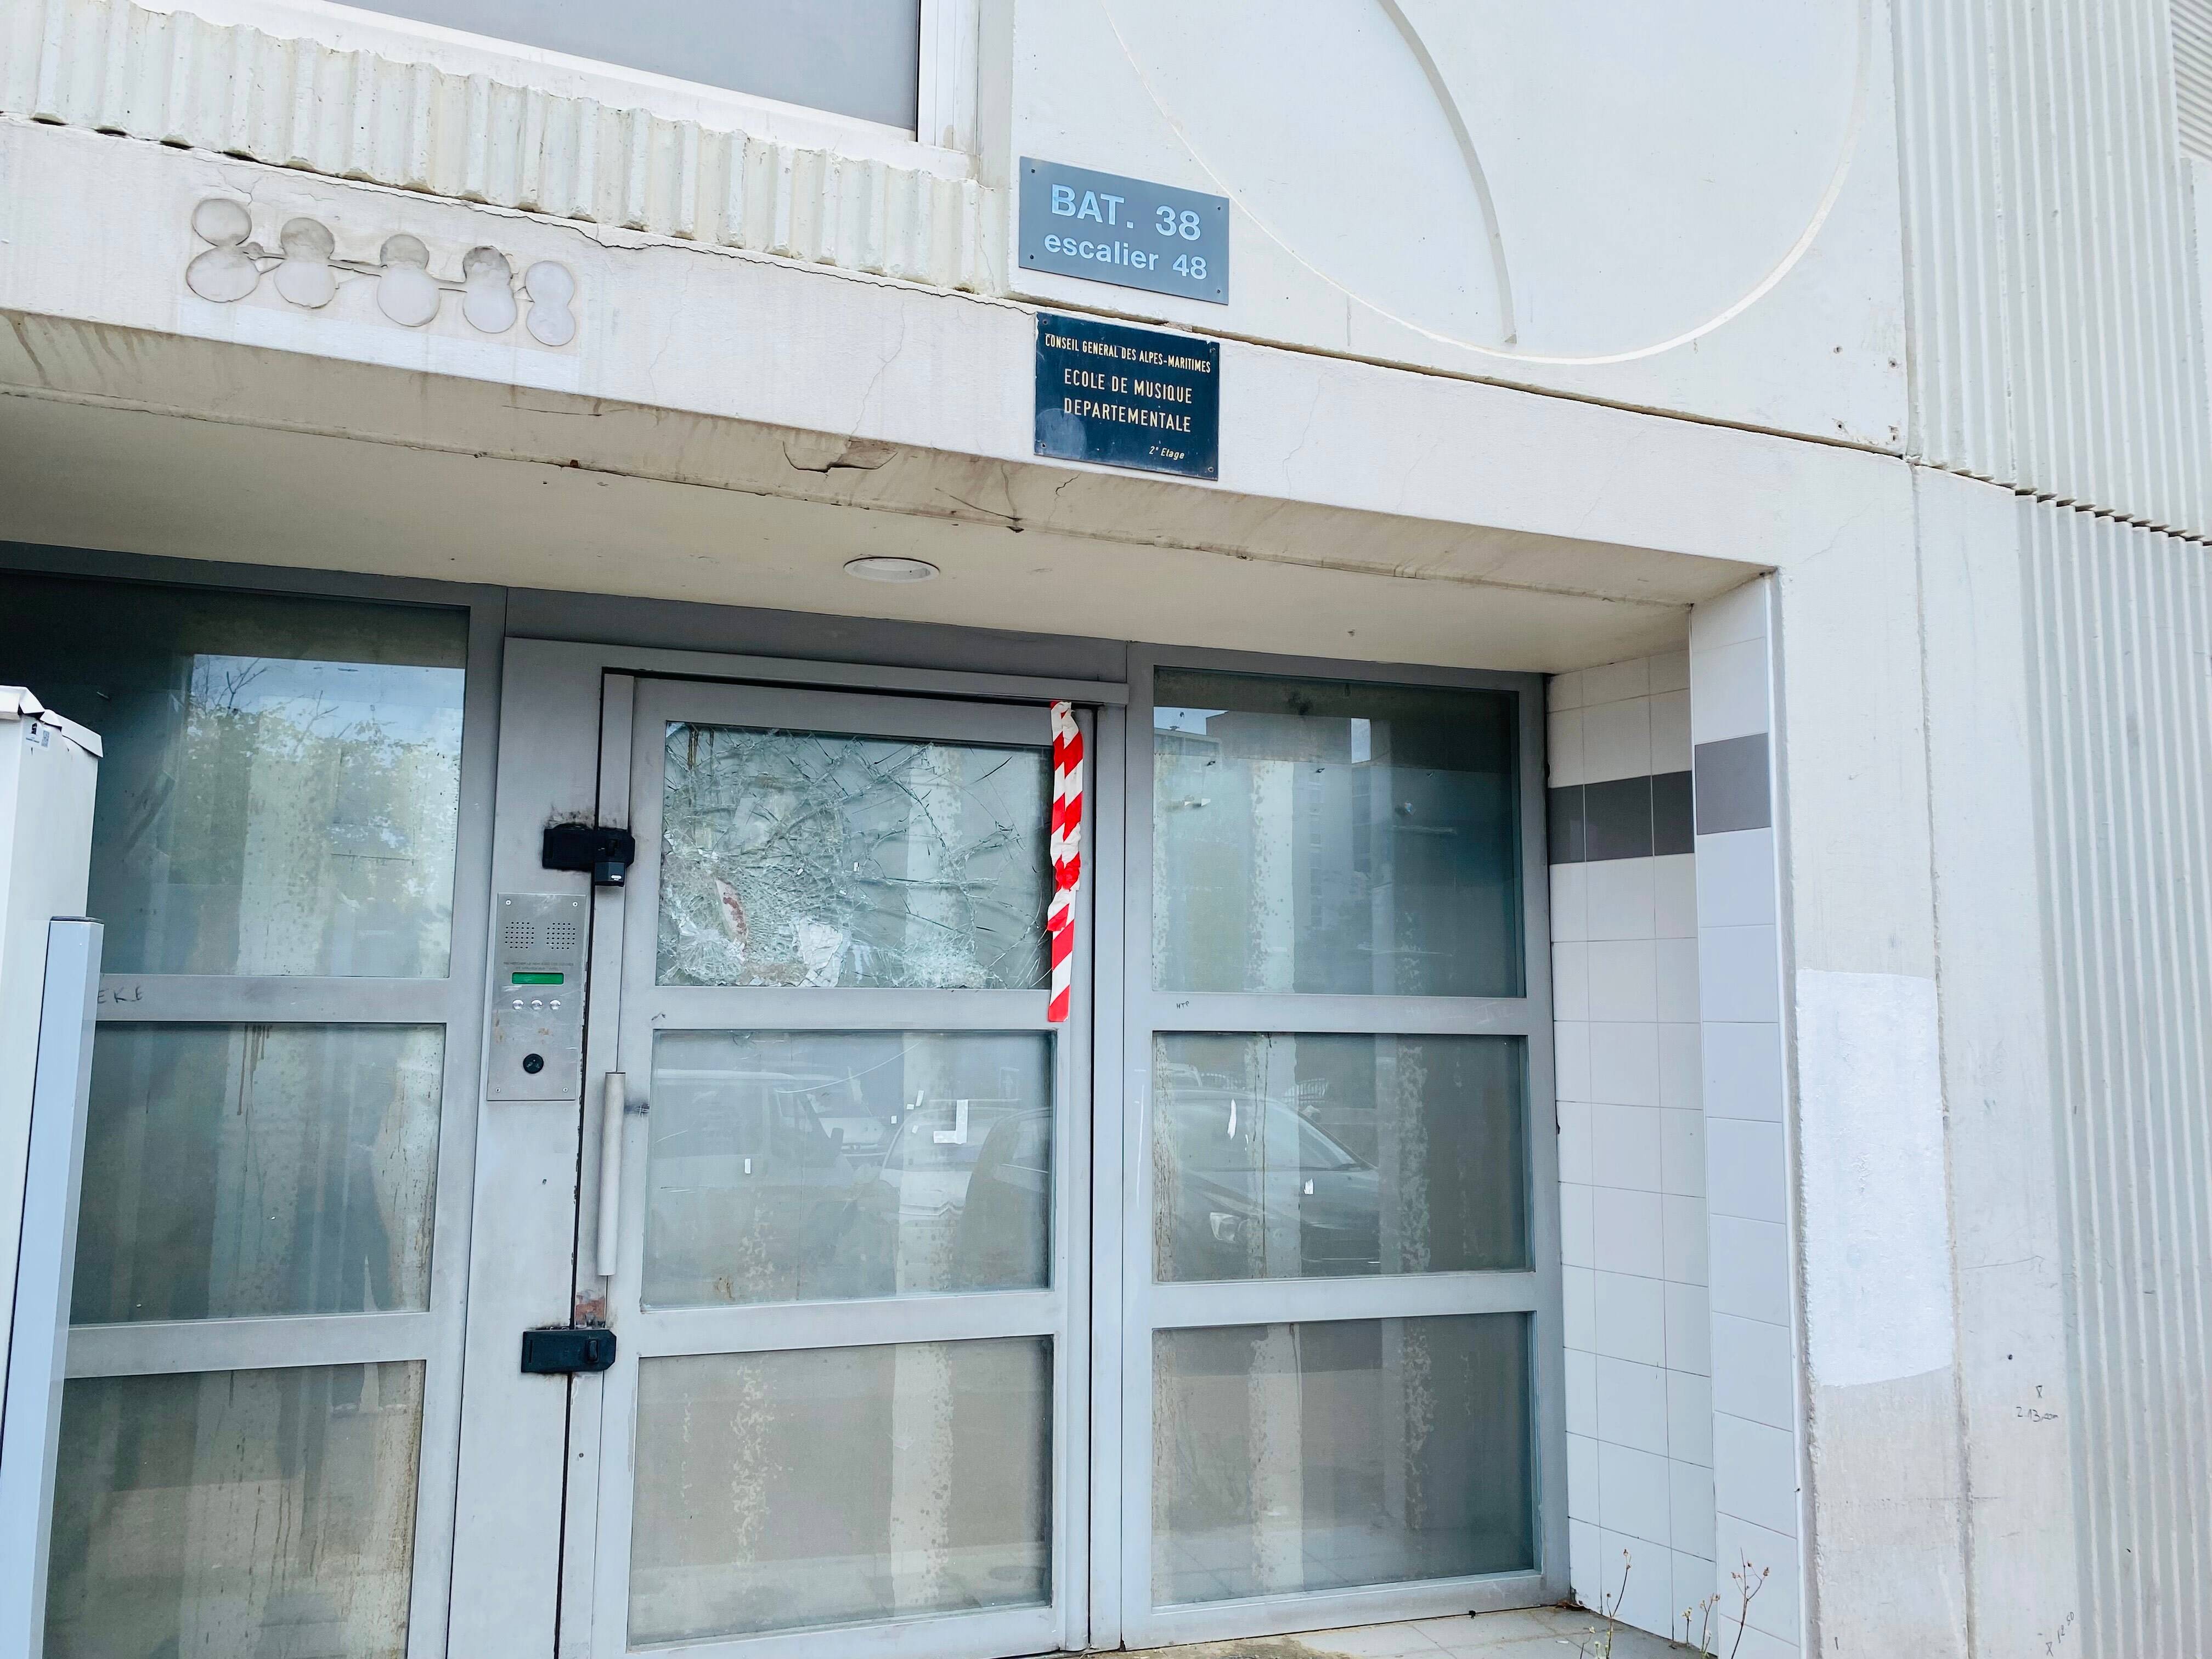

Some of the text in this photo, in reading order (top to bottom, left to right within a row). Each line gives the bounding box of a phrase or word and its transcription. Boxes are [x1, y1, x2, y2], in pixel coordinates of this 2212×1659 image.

[1051, 184, 1201, 241] BAT. 38
[1044, 234, 1207, 280] escalier 48
[1045, 334, 1211, 374] CONSEIL GENERAL DES ALPES-MARITIMES
[1064, 368, 1192, 404] ECOLE DE MUSIQUE
[1064, 397, 1191, 433] DEPARTEMENTALE
[1160, 447, 1185, 460] Etage
